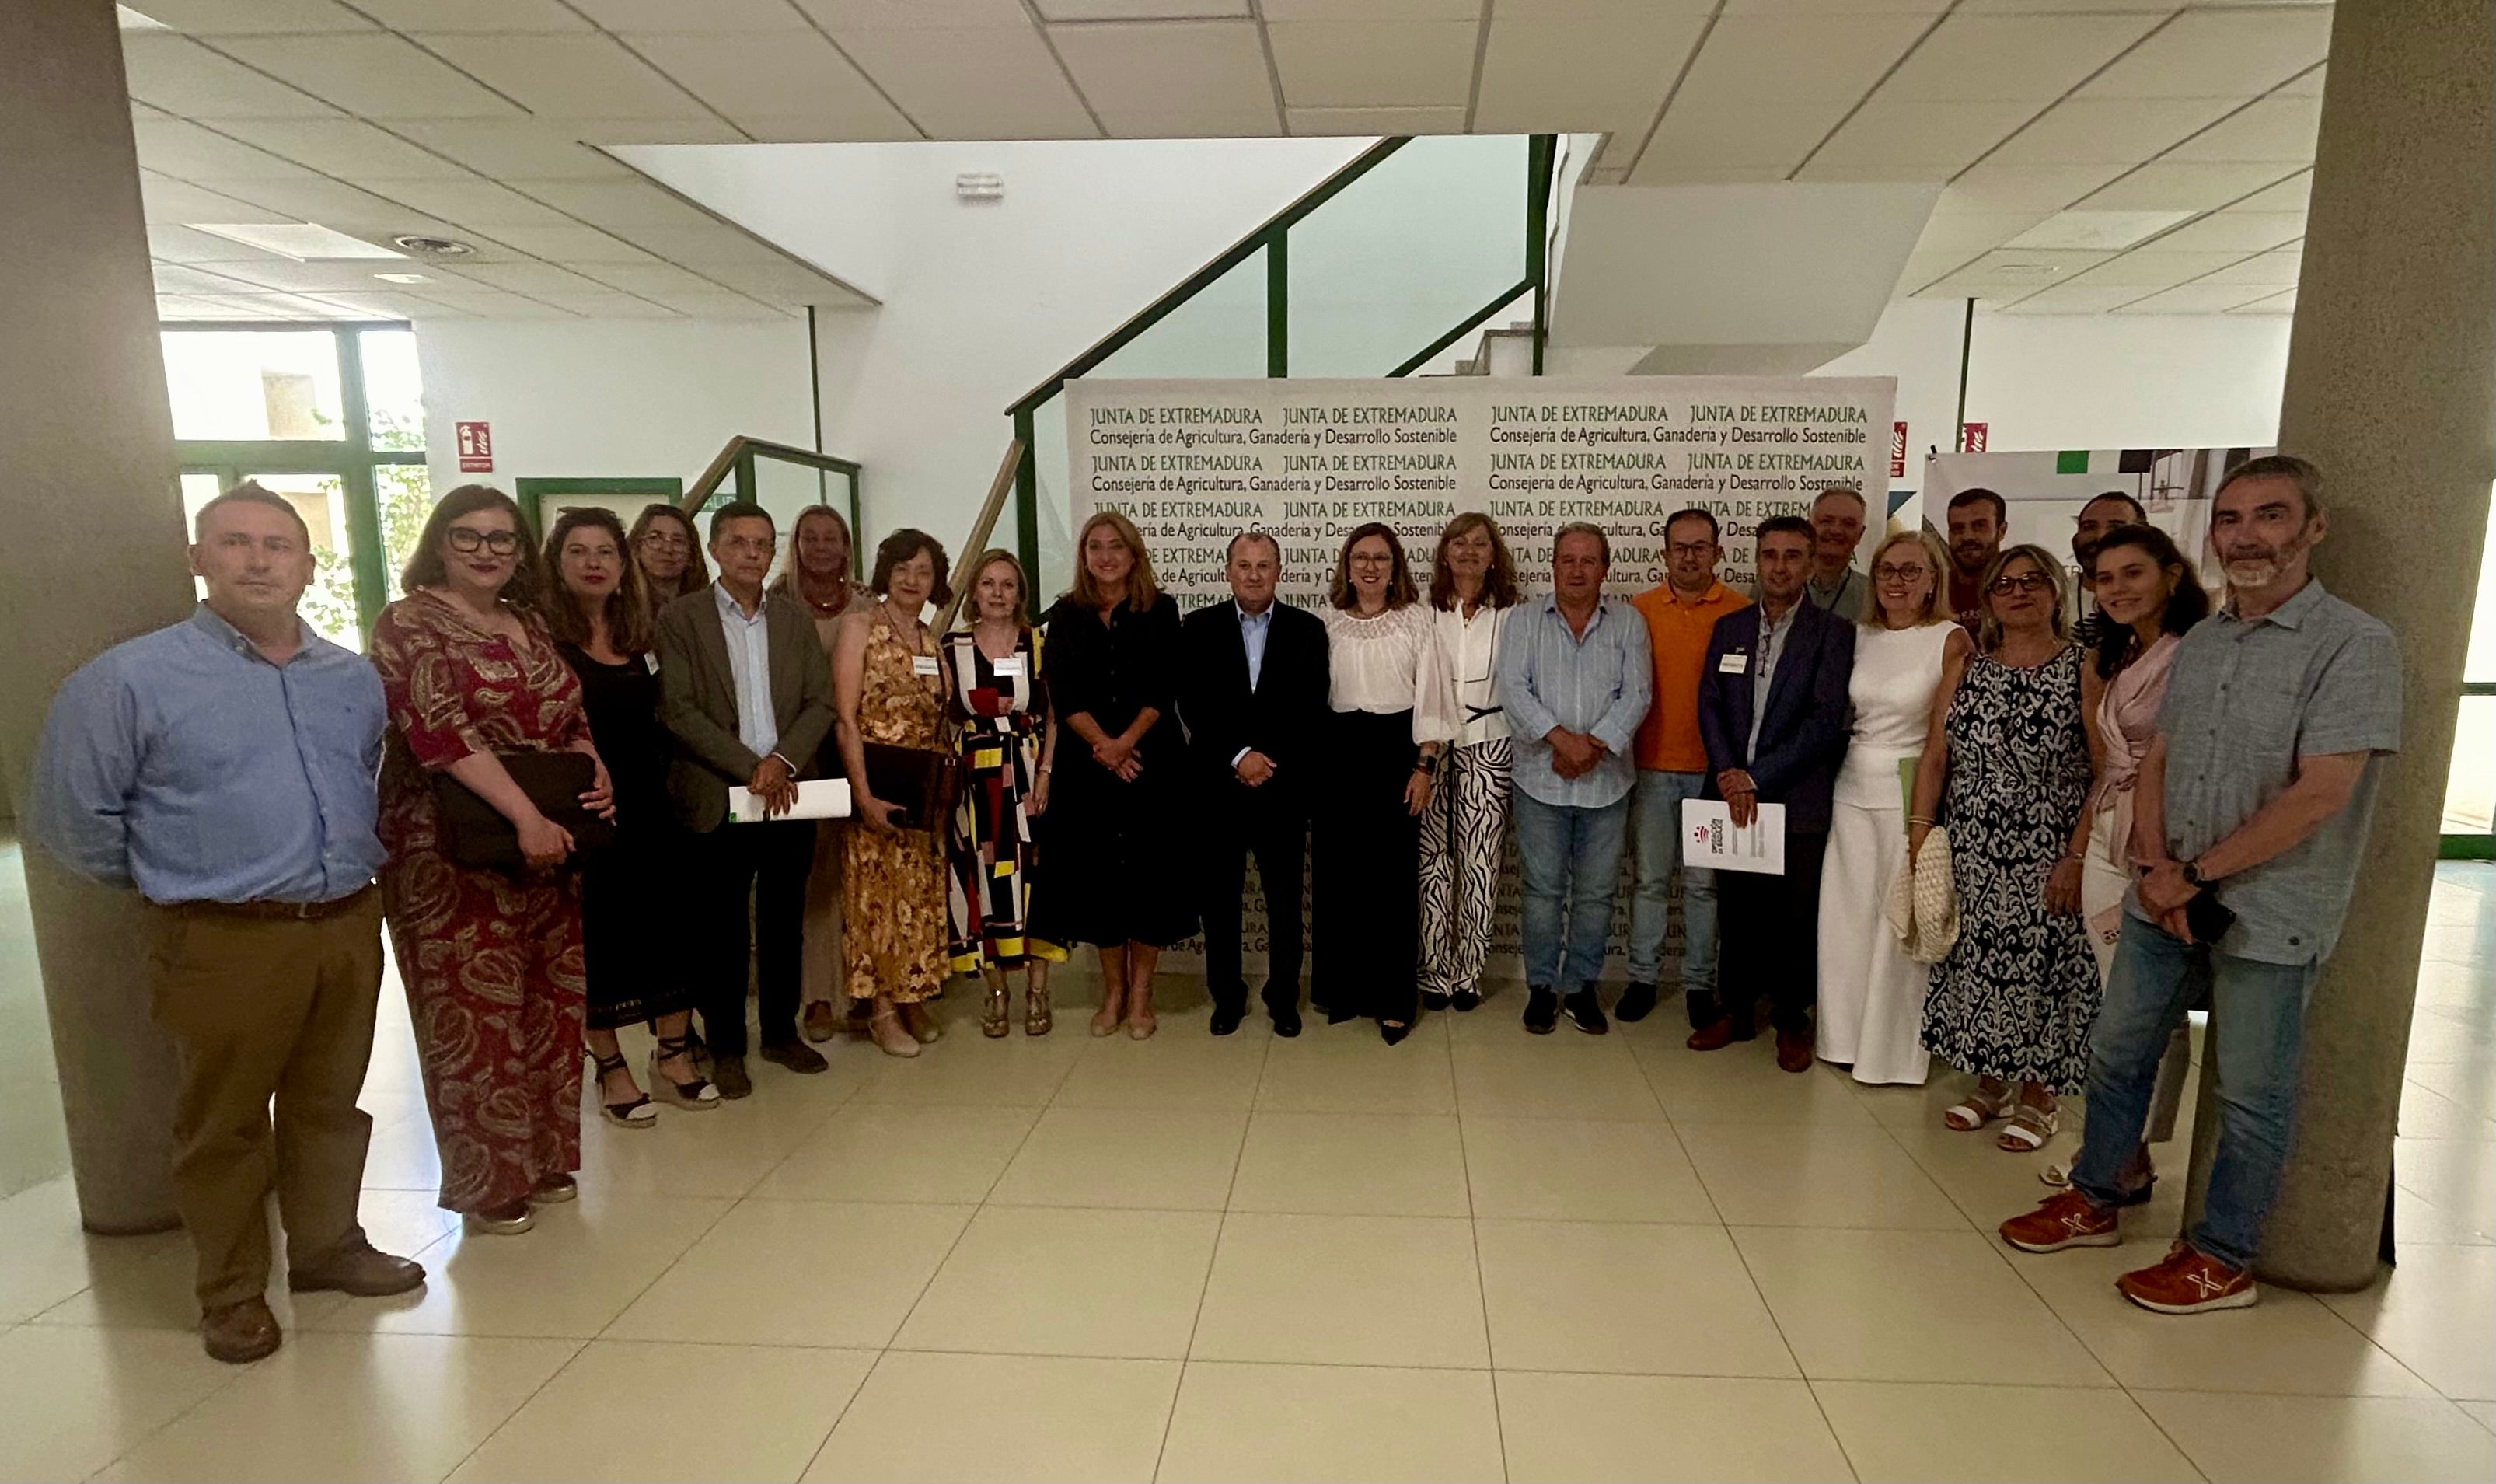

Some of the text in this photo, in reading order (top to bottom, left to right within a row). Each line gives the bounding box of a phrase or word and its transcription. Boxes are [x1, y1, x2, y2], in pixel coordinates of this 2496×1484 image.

[1090, 407, 1262, 427] JUNTA DE EXTREMADURA
[1283, 407, 1457, 427] JUNTA DE EXTREMADURA
[1492, 405, 1668, 424] JUNTA DE EXTREMADURA
[1690, 405, 1868, 424] JUNTA DE EXTREMADURA
[1090, 427, 1457, 449] Consejería de Agricultura, Ganadería y Desarrollo Sostenible
[1490, 426, 1866, 447] Consejería de Agricultura, Ganadería y Desarrollo Sostenible
[1092, 455, 1263, 473] JUNTA DE EXTREMADURA
[1283, 454, 1457, 474] JUNTA DE EXTREMADURA
[1490, 453, 1667, 472] JUNTA DE EXTREMADURA
[1688, 452, 1864, 472] JUNTA DE EXTREMADURA
[1092, 474, 1456, 495] Consejería de Agricultura, Ganadería y Desarrollo Sostenible
[1489, 473, 1862, 494] Consejería de Agricultura, Ganadería y Desarrollo Sostenible
[1142, 501, 1157, 518] DE
[1161, 501, 1263, 518] EXTREMADURA
[1283, 501, 1456, 520] JUNTA DE EXTREMADURA
[1490, 500, 1664, 517] JUNTA DE EXTREMADURA
[1736, 501, 1752, 517] DE
[1756, 501, 1810, 517] EXTREM
[1160, 522, 1175, 537] de
[1178, 522, 1243, 541] Agricultura
[1314, 526, 1322, 542] y
[1395, 522, 1447, 537] Sostenib
[1499, 522, 1552, 540] onsejería
[1163, 548, 1227, 564] EXTREMA
[1284, 548, 1328, 566] JUNTA
[1732, 547, 1749, 564] DE
[1161, 567, 1176, 585] de
[1178, 569, 1225, 586] Agricult
[1281, 569, 1311, 583] dería
[1314, 572, 1322, 587] y
[1512, 568, 1551, 586] sejería
